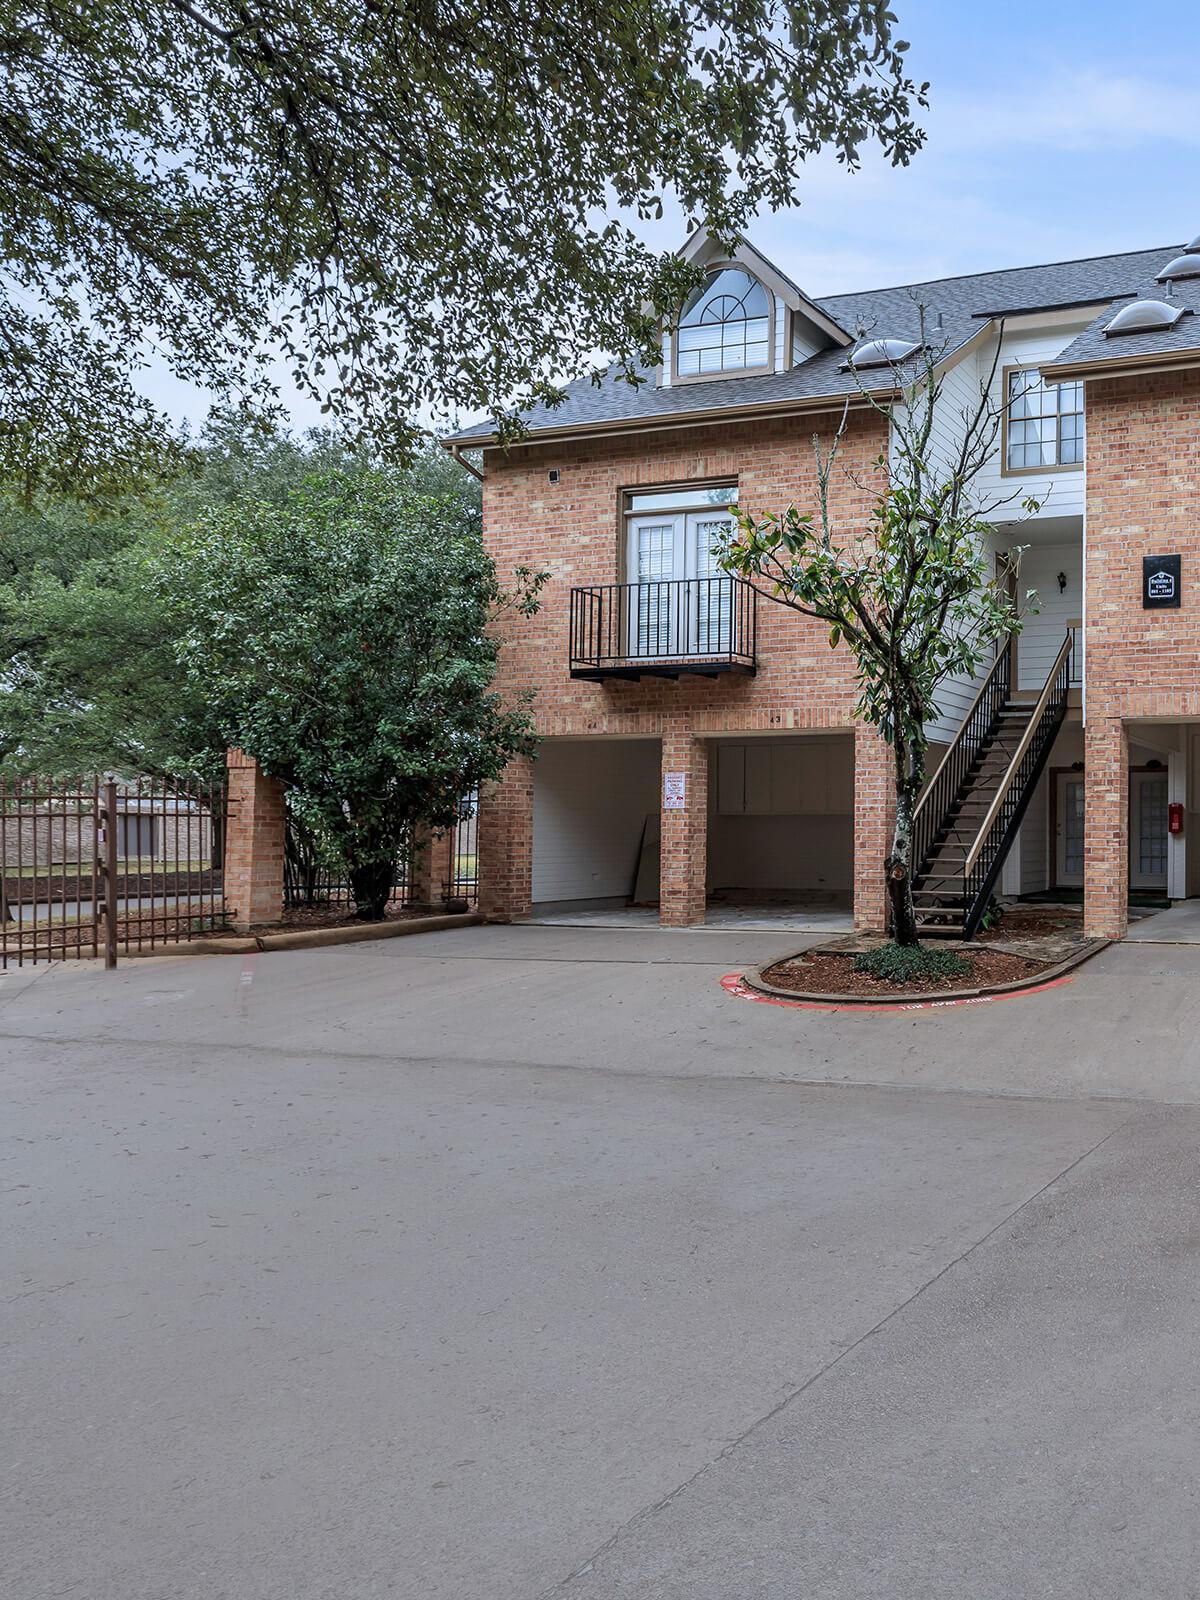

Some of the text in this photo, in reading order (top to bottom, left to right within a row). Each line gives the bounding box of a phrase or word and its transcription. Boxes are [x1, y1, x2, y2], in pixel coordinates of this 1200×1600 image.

[770, 715, 781, 724] 43
[587, 721, 597, 729] 44
[900, 1003, 924, 1011] TOW
